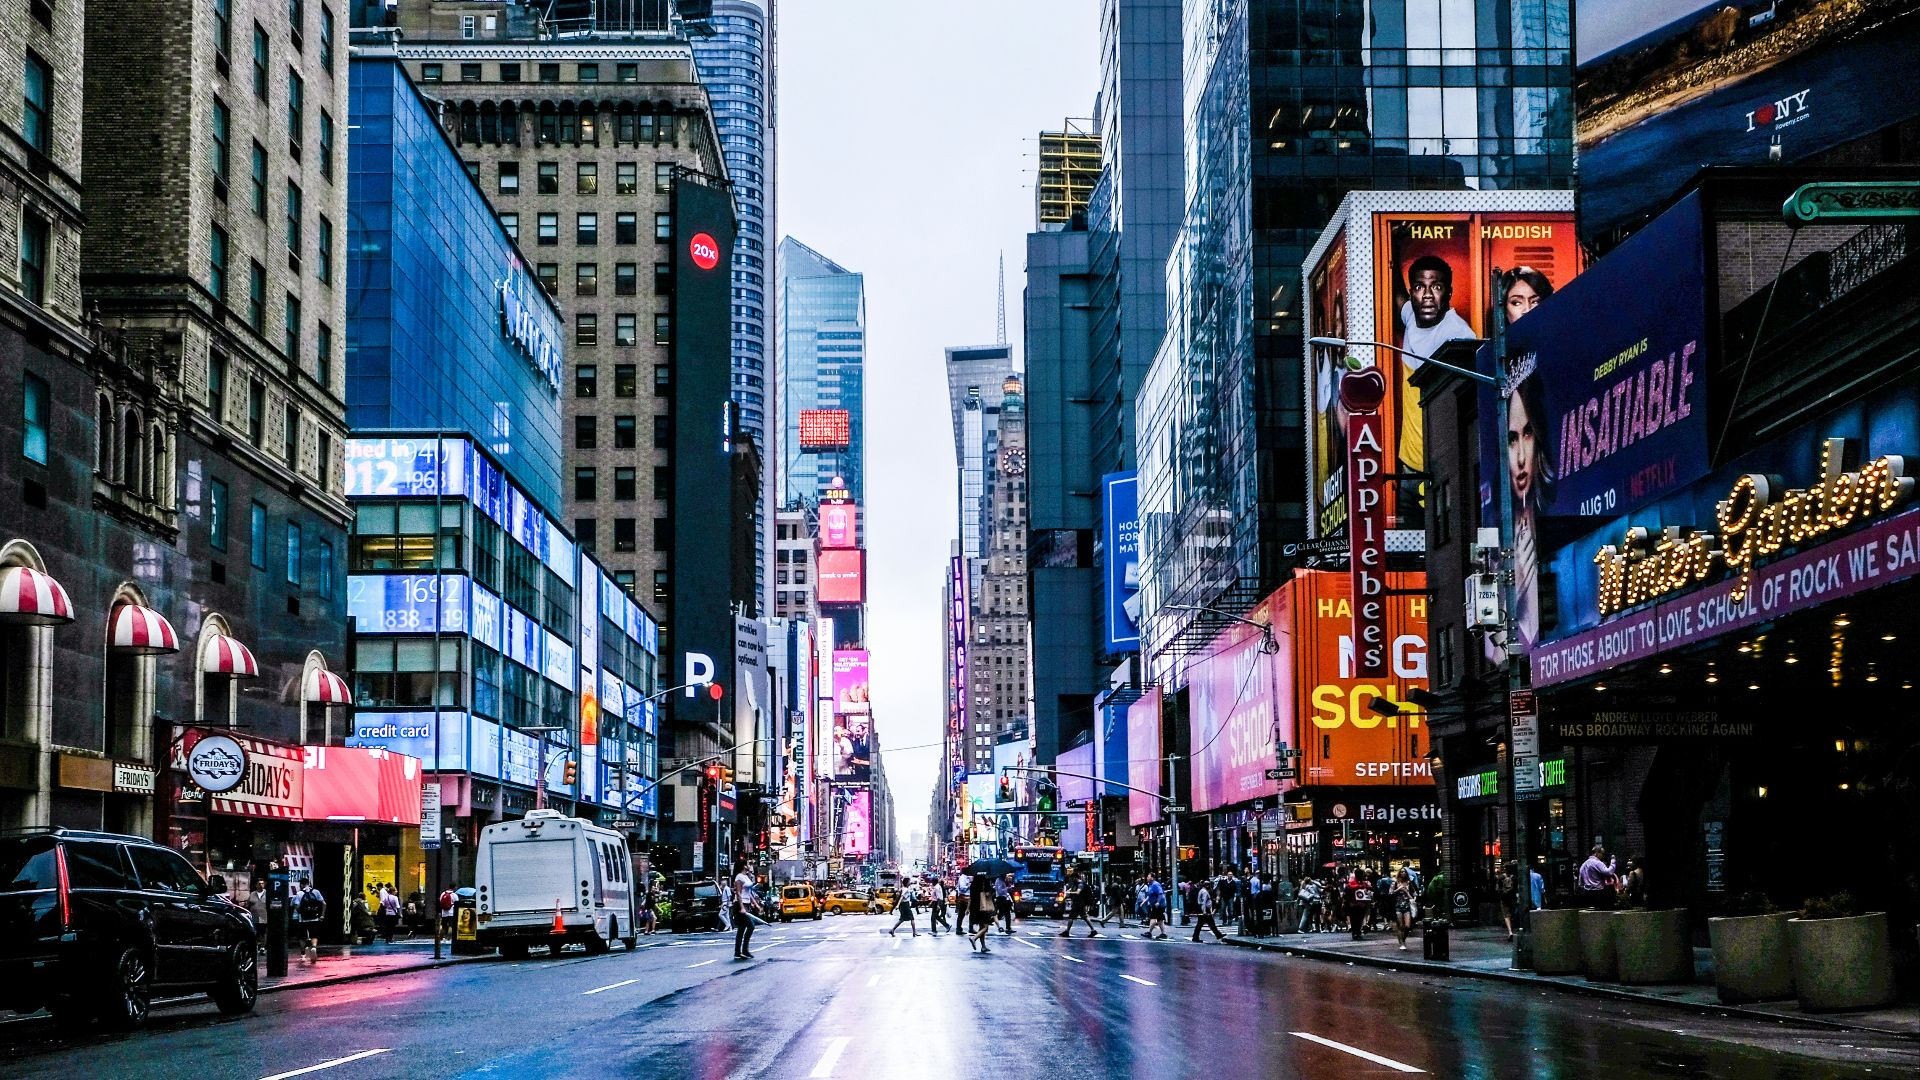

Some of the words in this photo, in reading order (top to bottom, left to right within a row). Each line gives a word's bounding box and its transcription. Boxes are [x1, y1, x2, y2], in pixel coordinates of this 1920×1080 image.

[1746, 111, 1755, 132] I
[1775, 89, 1810, 120] NY
[1411, 226, 1453, 239] HART
[1481, 225, 1552, 239] HADDISH
[694, 243, 715, 260] 20x
[1593, 354, 1619, 382] DEBBY
[1619, 341, 1640, 366] RYAN
[1640, 337, 1648, 354] IS
[1558, 339, 1697, 481] INSATIABLE
[1323, 465, 1344, 508] NIGHT
[1631, 455, 1677, 500] NETFLIX
[1321, 493, 1348, 538] SCHOOL
[1580, 496, 1602, 516] AUG
[1605, 487, 1616, 510] 10
[1716, 439, 1903, 604] Garden
[1352, 423, 1384, 668] Applebee's
[1594, 526, 1715, 615] Winter
[953, 558, 964, 642] LADY
[1561, 639, 1595, 674] THOSE
[1597, 625, 1636, 663] ABOUT
[1639, 619, 1655, 649] TO
[1658, 605, 1693, 644] LOVE
[1697, 585, 1758, 632] SCHOOL
[1761, 573, 1785, 611] OF
[1789, 553, 1844, 603] ROCK,
[1847, 540, 1880, 583] WE
[738, 622, 757, 636] wrinkles
[738, 640, 748, 649] can
[748, 641, 758, 651] now
[758, 642, 764, 653] be
[359, 724, 397, 738] credit
[400, 724, 430, 738] card
[1559, 723, 1584, 737] HAS
[1586, 723, 1650, 737] BROADWAY
[1655, 722, 1708, 736] ROCKING
[1675, 711, 1718, 722] WEBBER
[200, 759, 236, 769] FRIDAY'S
[240, 761, 291, 801] RIDAY'S
[1545, 759, 1565, 787] COFFEE
[1481, 770, 1498, 796] COFFEE
